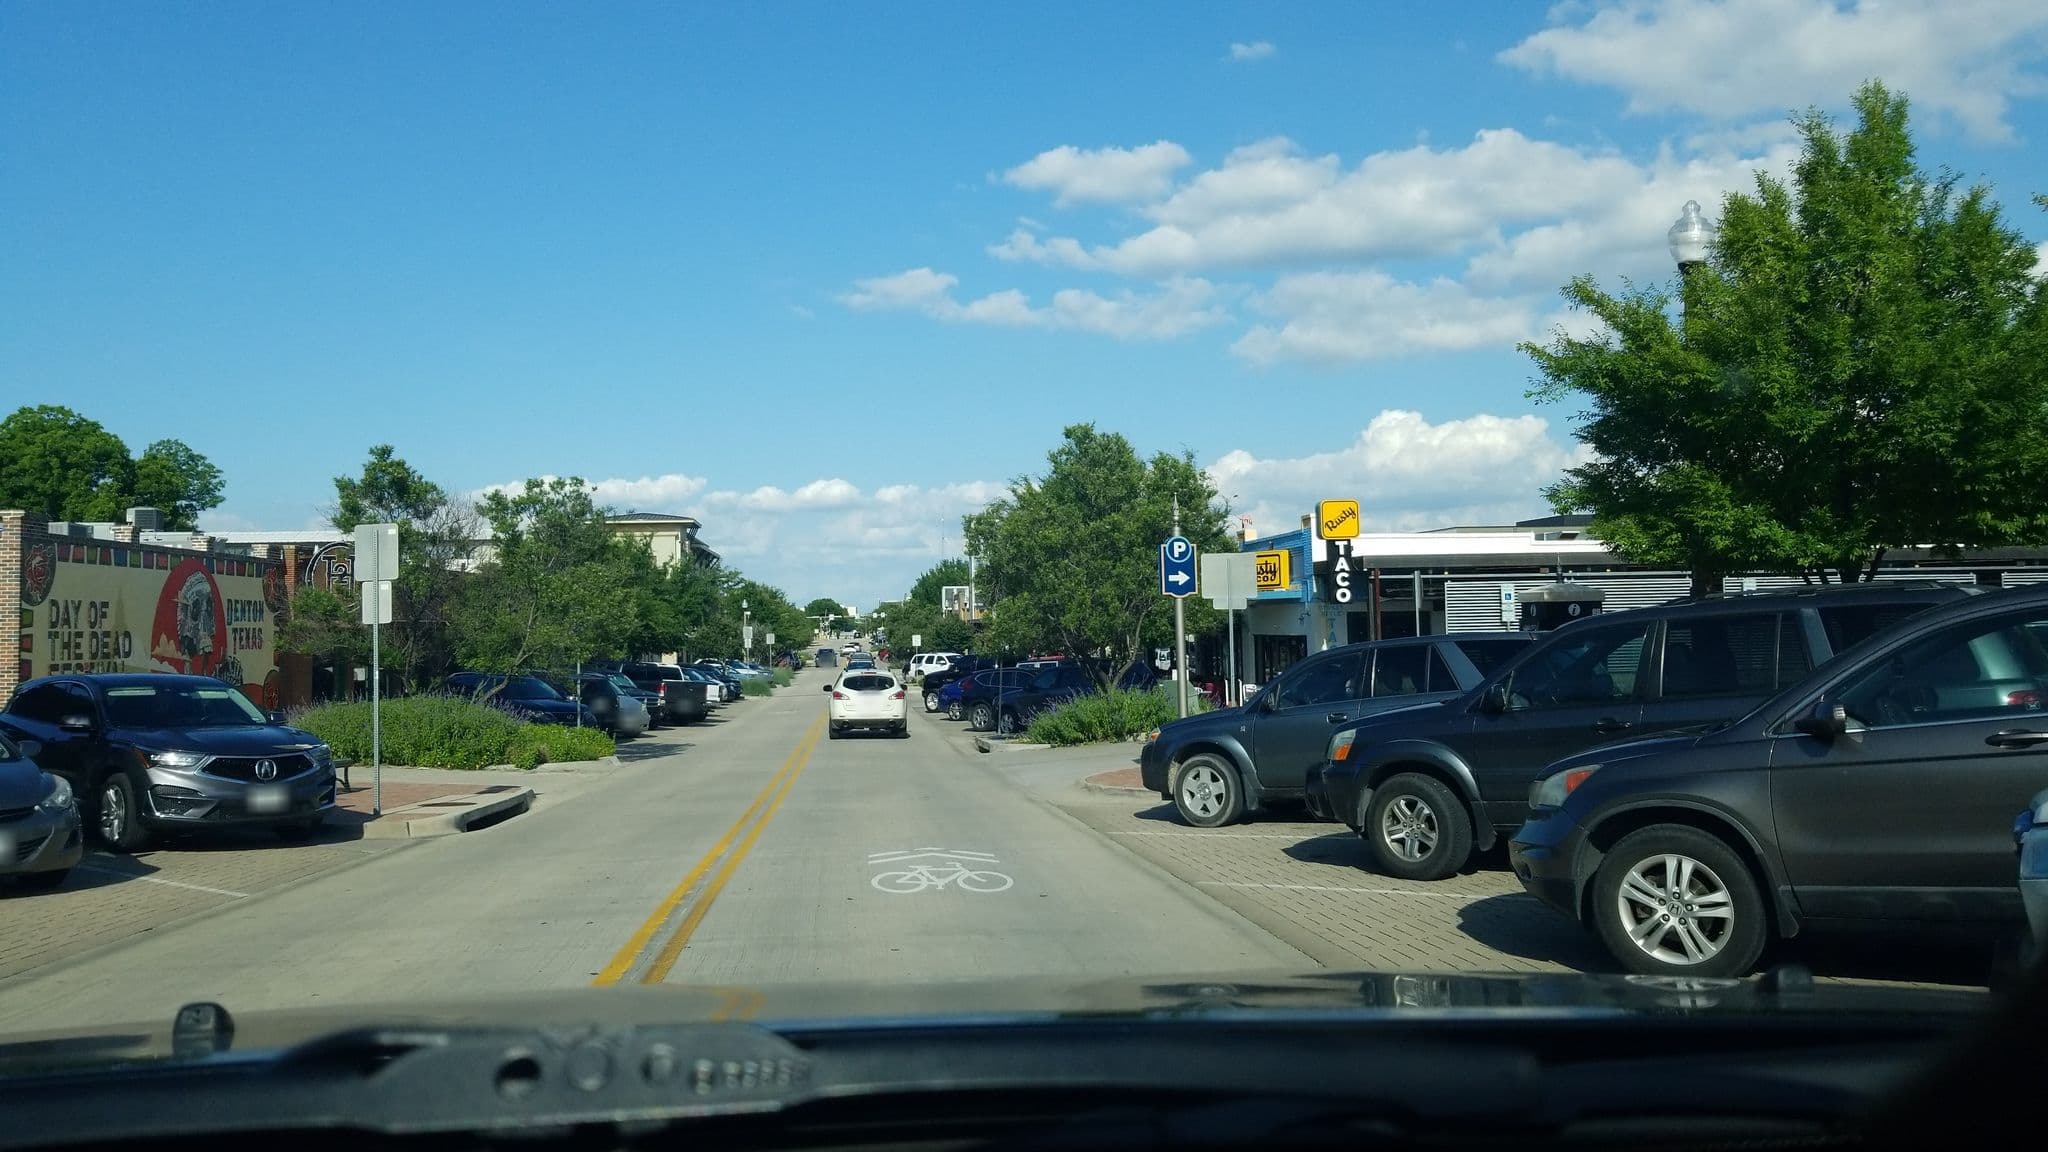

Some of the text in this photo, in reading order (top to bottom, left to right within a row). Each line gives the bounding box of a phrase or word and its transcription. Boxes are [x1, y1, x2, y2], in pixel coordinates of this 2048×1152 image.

[1324, 507, 1356, 532] Rusty
[1173, 541, 1187, 558] P
[1256, 559, 1277, 582] usty
[1334, 541, 1352, 603] TACO
[49, 599, 109, 629] DAY OF
[227, 598, 264, 626] DENTON
[48, 630, 132, 661] THE DEAD
[232, 627, 263, 655] TEXAS
